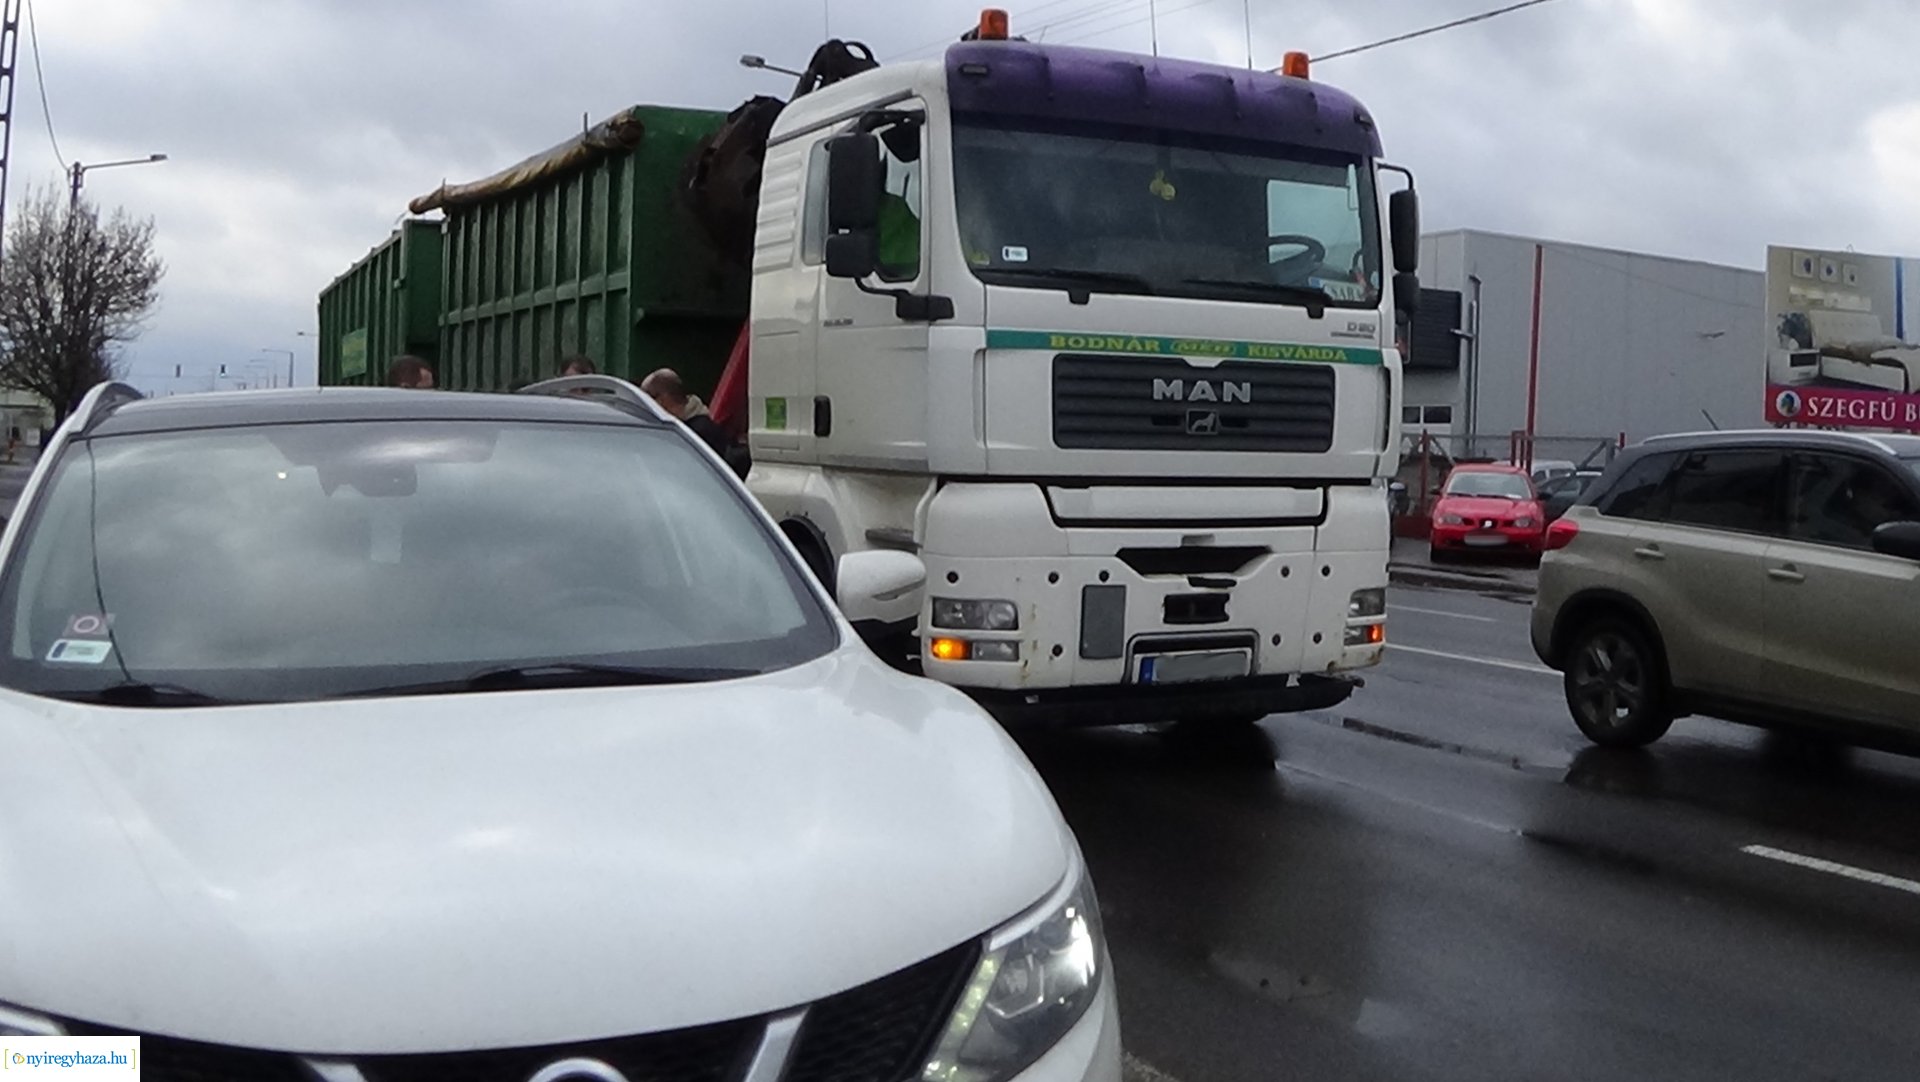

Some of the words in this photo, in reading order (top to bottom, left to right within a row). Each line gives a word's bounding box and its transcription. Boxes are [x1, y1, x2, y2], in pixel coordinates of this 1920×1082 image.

[1050, 335, 1161, 352] BODNÁR
[1248, 344, 1348, 361] KISVÁRDA
[1153, 378, 1251, 403] MAN
[1905, 402, 1920, 422] B
